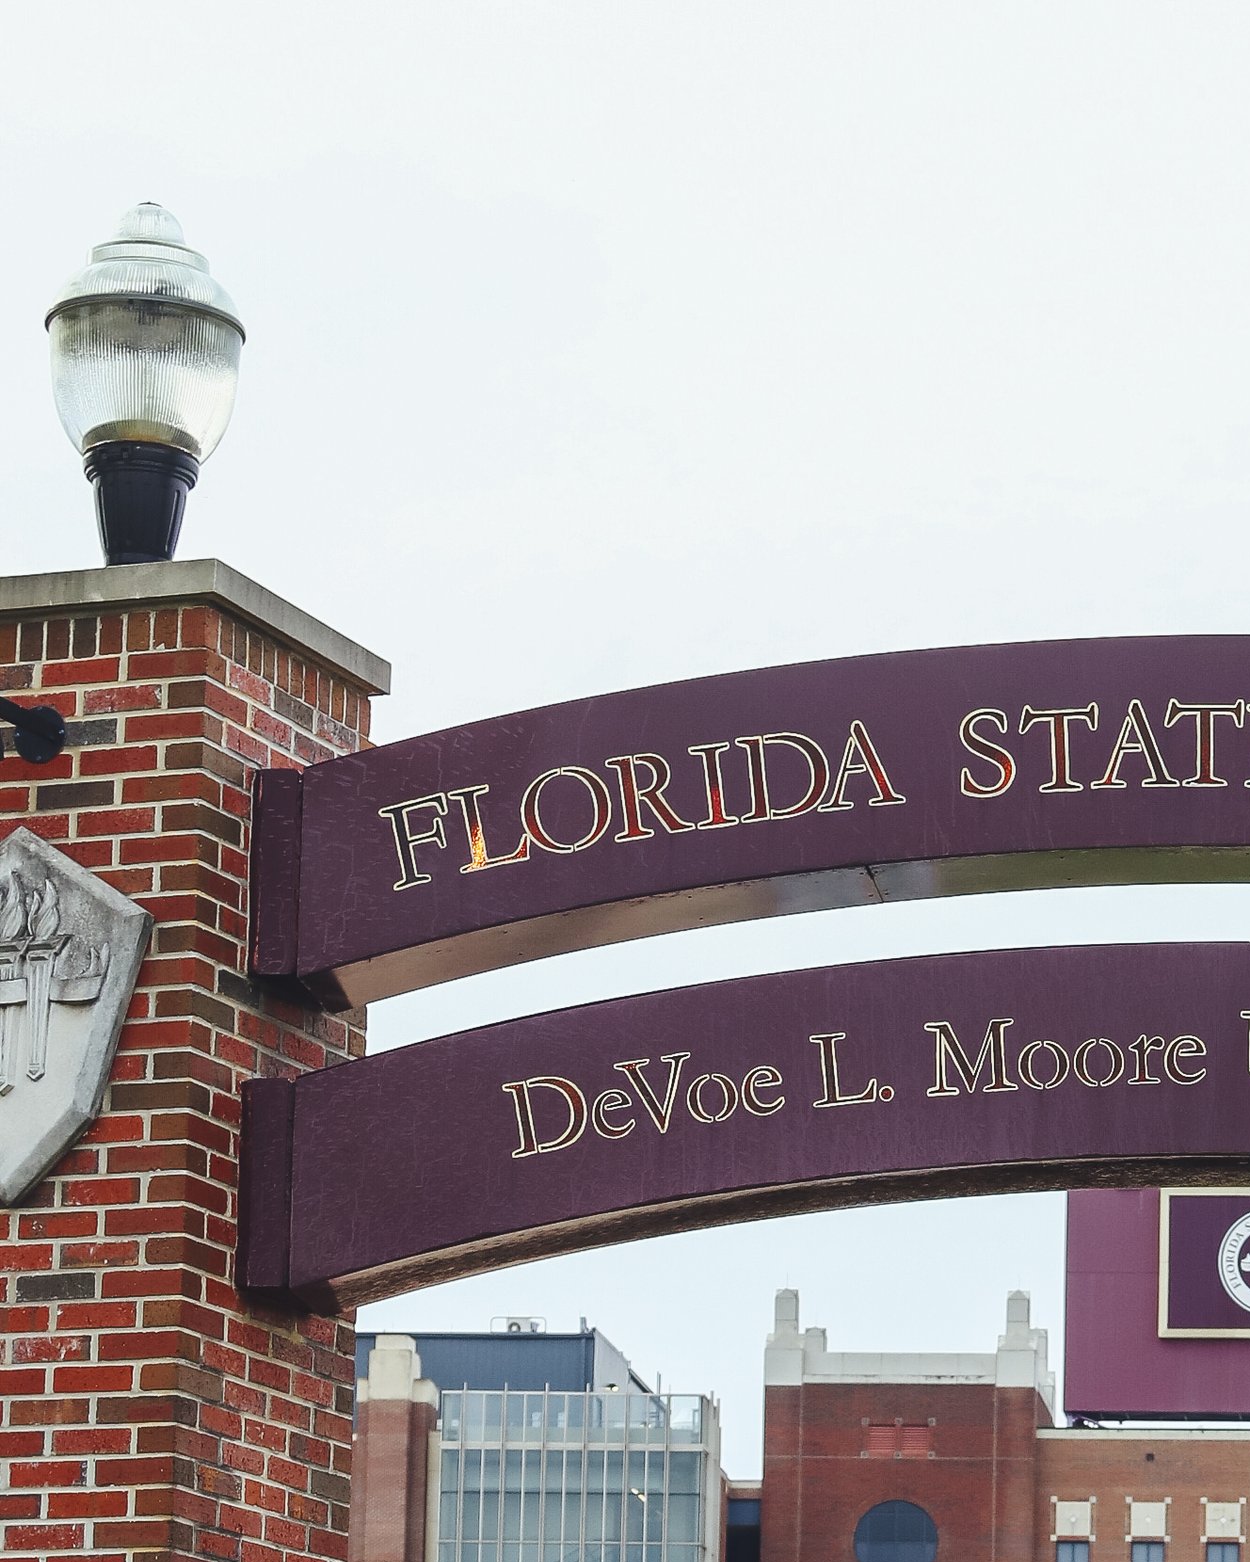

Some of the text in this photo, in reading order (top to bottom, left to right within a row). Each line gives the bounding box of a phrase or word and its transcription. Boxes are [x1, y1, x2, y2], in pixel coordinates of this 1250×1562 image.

[379, 719, 906, 892] FLORIDA
[501, 1051, 786, 1159] DeVoe
[808, 1032, 895, 1108] L.
[923, 1018, 1207, 1097] Moore
[1225, 1232, 1245, 1290] FLORIDA
